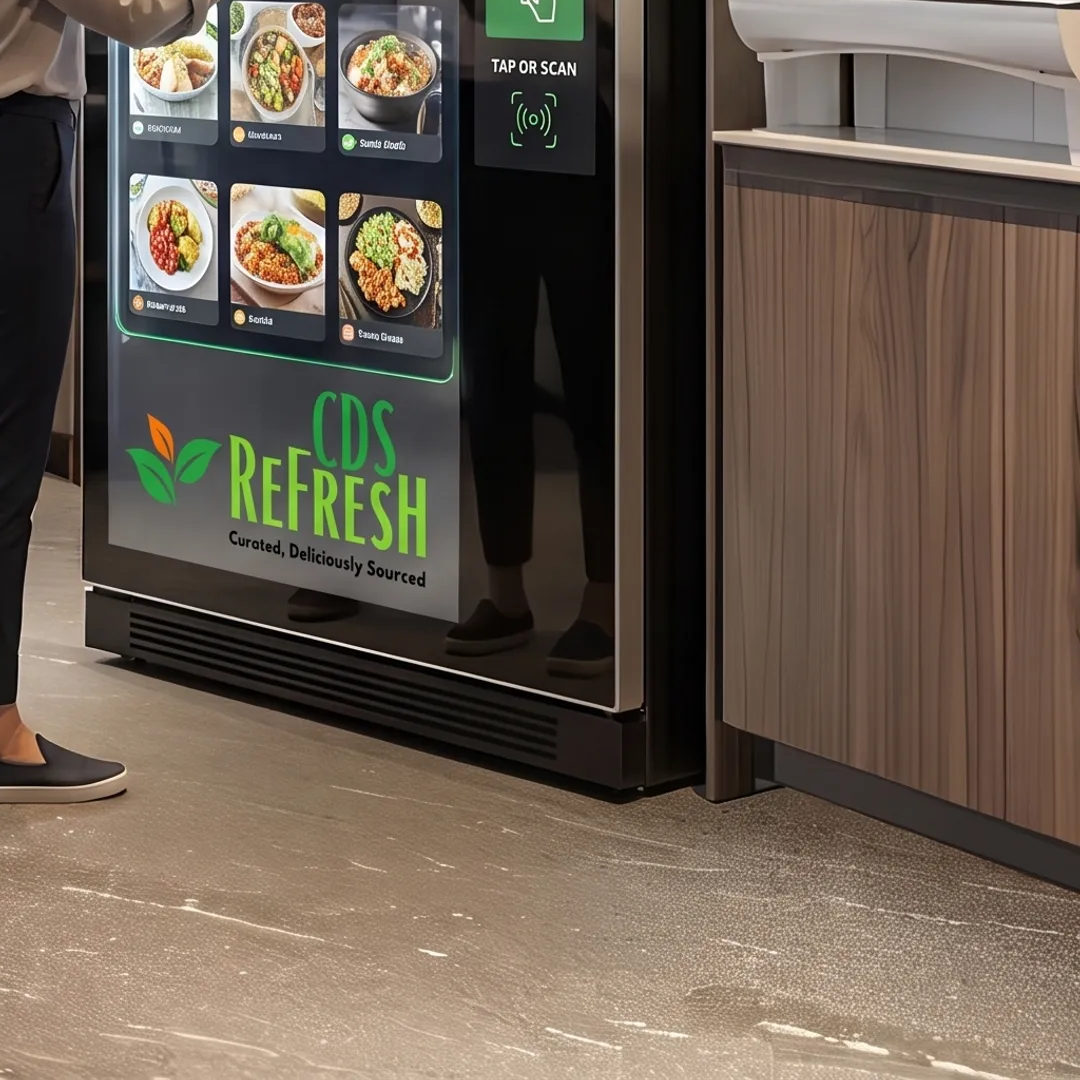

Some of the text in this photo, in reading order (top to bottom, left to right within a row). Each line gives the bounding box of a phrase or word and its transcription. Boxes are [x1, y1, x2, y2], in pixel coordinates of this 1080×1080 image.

[492, 59, 577, 77] TAP OR SCAN
[312, 390, 396, 477] CDS
[229, 530, 427, 588] Curated, Deliciously Sourced
